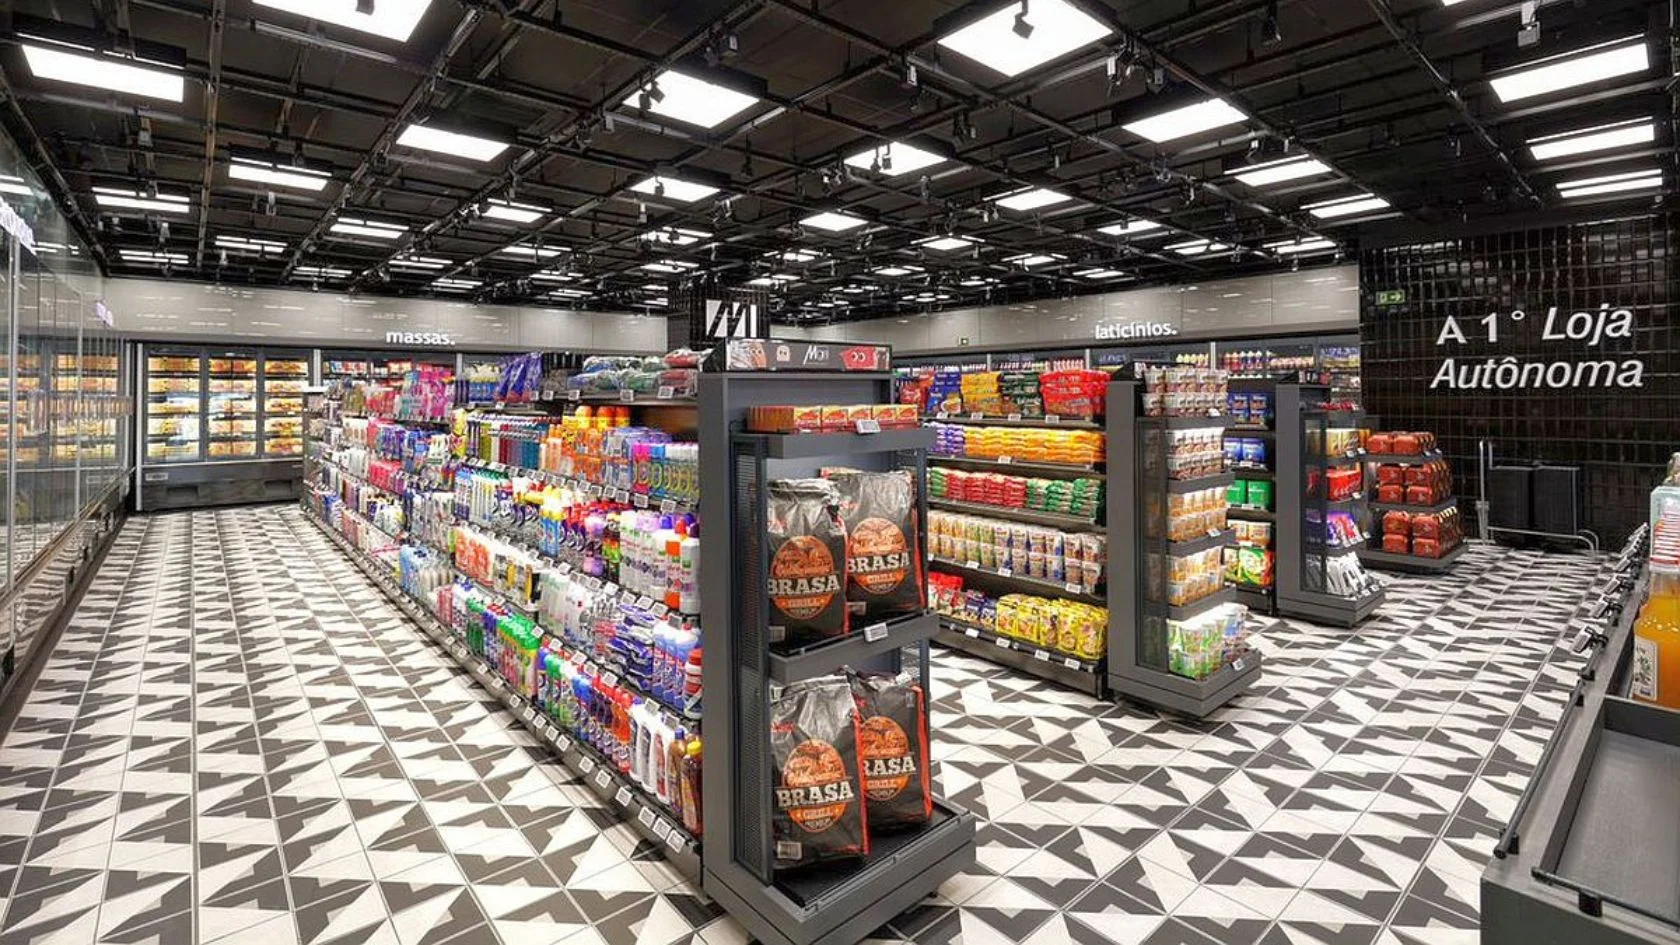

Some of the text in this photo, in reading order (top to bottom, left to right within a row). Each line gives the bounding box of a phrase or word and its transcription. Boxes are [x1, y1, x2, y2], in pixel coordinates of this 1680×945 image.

[1436, 315, 1467, 345] A
[1541, 303, 1633, 346] Loja
[385, 331, 456, 346] massas.
[1429, 356, 1645, 389] Autônoma
[847, 551, 910, 573] BRASA
[768, 574, 841, 595] BRASA
[864, 755, 917, 777] RASA
[776, 780, 855, 808] BRASA
